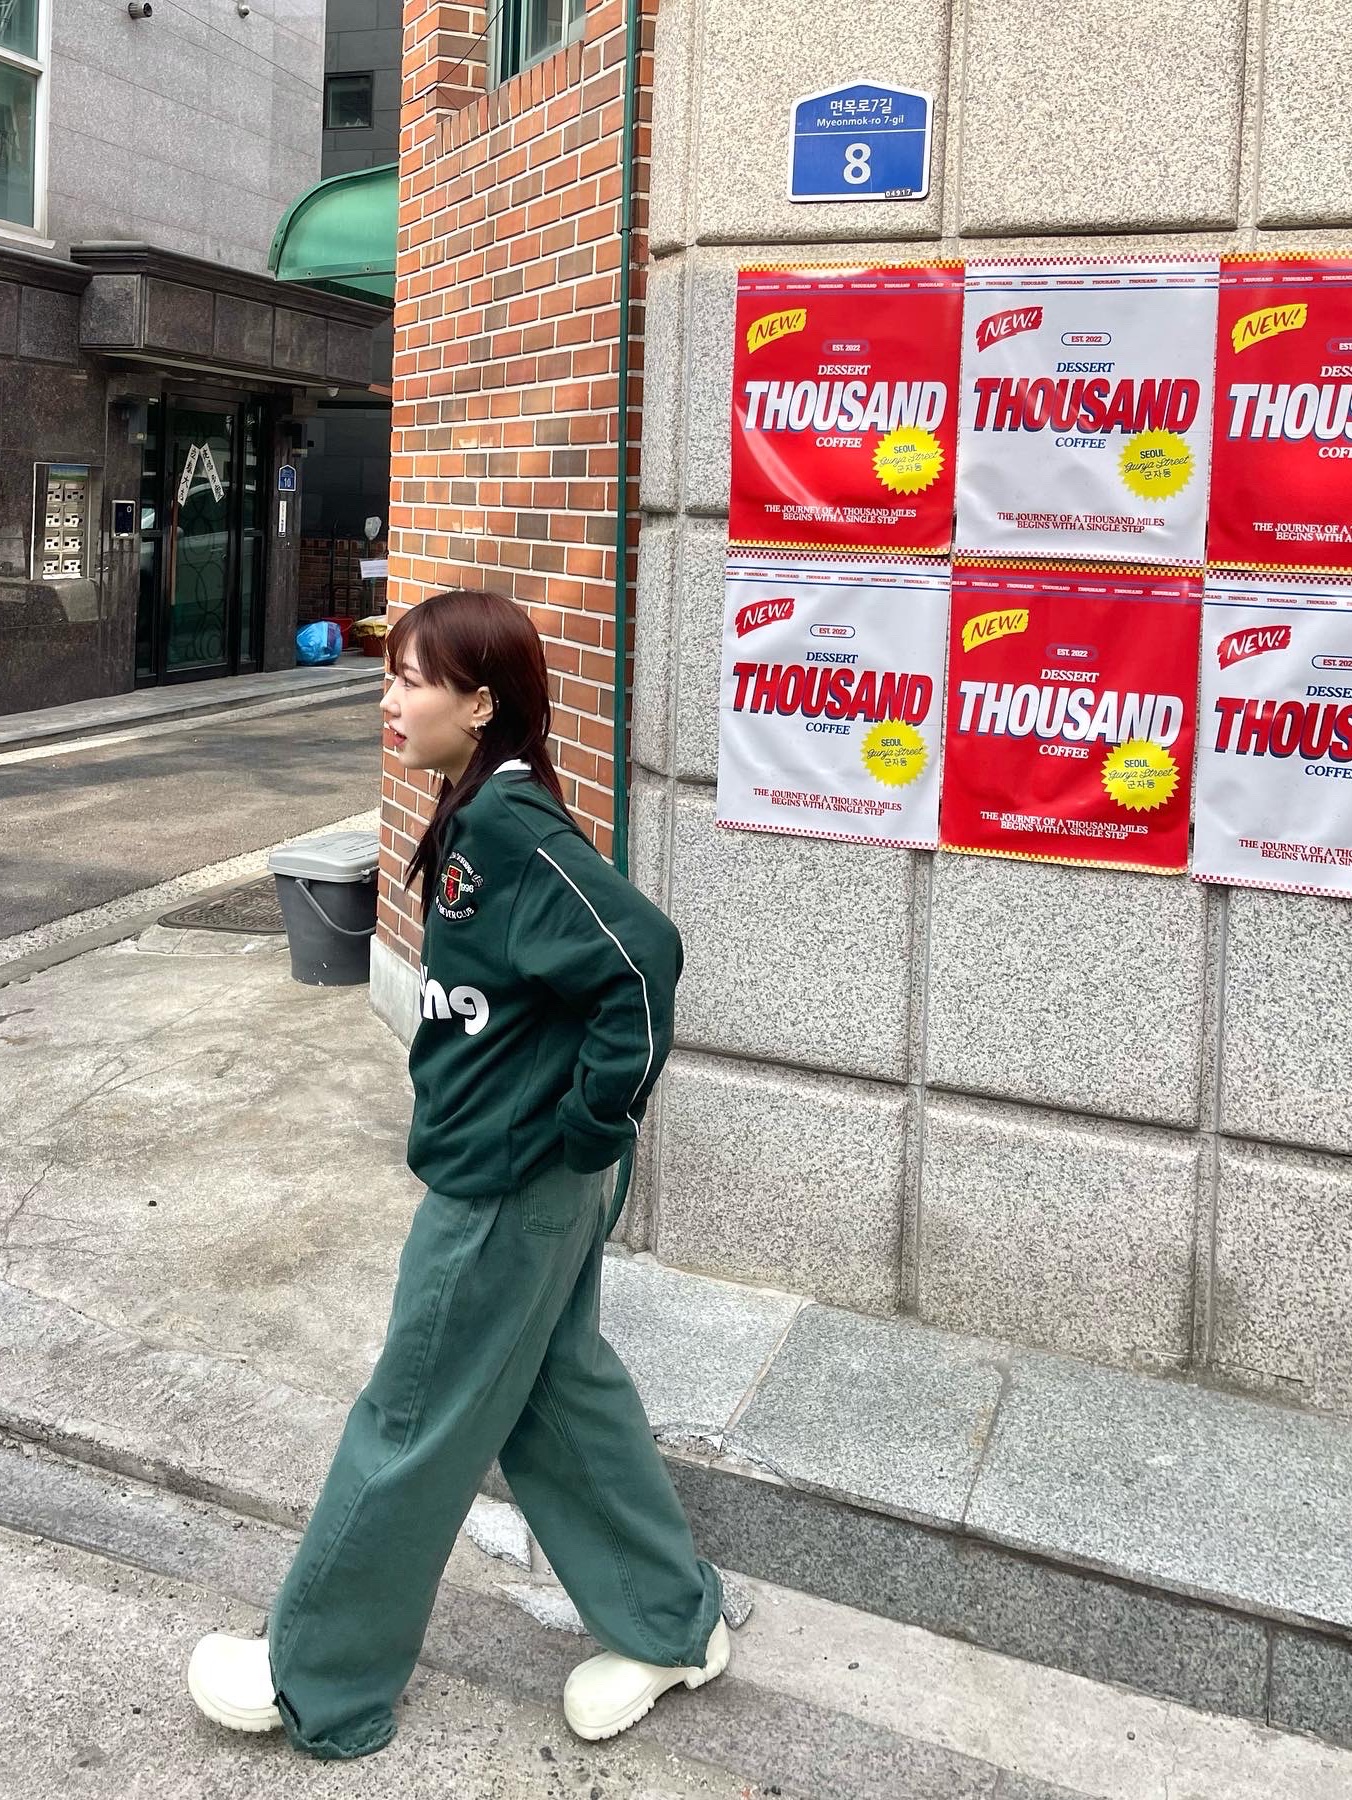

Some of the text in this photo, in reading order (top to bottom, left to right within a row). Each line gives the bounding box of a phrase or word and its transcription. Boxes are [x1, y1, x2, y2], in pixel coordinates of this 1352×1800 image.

[830, 98, 892, 115] 면목로7길
[816, 115, 904, 129] Myeonmok-ro 7-gil
[844, 143, 871, 185] 8
[755, 313, 801, 343] NEW!
[984, 310, 1037, 342] NEW!
[1242, 308, 1300, 342] NEW!
[818, 364, 871, 376] DESSERT
[1056, 362, 1115, 373] DESSERT
[744, 380, 947, 432] THOUSAND
[973, 377, 1201, 434] THOUSAND
[815, 437, 862, 448] COFFEE
[894, 445, 917, 454] SEOUL
[1055, 437, 1106, 449] COFFEE
[1140, 449, 1166, 459] SEOUL
[1156, 456, 1189, 468] Street
[764, 504, 780, 512] THE
[782, 505, 820, 514] JOURNEY
[822, 506, 834, 515] OF
[842, 507, 889, 516] THOUSAND
[891, 509, 917, 517] MILES
[783, 513, 813, 521] BEGINS
[815, 514, 836, 522] WITH
[845, 515, 876, 524] SINGLE
[877, 516, 898, 524] STEP
[997, 512, 1014, 521] THE
[1015, 513, 1059, 522] JOURNEY
[1060, 514, 1072, 523] OF
[1083, 515, 1135, 525] THOUSAND
[1137, 518, 1165, 527] MILES
[1017, 520, 1050, 529] BEGINS
[1051, 522, 1076, 530] WITH
[1087, 523, 1120, 532] SINGLE
[1122, 524, 1145, 533] STEP
[1253, 522, 1348, 534] THE JOURNEY OF A
[1276, 532, 1352, 543] BEGINS WITH A
[743, 602, 790, 630] NEW!
[970, 614, 1023, 642] NEW!
[1227, 629, 1285, 660] NEW!
[806, 651, 858, 664] DESSERT
[1057, 648, 1088, 657] EST. 2022
[1040, 668, 1100, 683] DESSERT
[733, 662, 933, 726] THOUSAND
[958, 681, 1184, 749] THOUSAND
[806, 722, 850, 735] COFFEE
[1215, 697, 1352, 763] THOUS
[881, 738, 902, 747] SEOUL
[894, 747, 923, 757] Street
[1039, 745, 1090, 759] COFFEE
[1124, 759, 1150, 768] SEOUL
[1140, 768, 1173, 778] Street
[753, 788, 769, 796] THE
[770, 789, 808, 801] JOURNEY
[810, 794, 821, 802] OF
[829, 796, 876, 808] THOUSAND
[877, 801, 902, 811] MILES
[771, 797, 800, 807] BEGINS
[802, 800, 824, 809] WITH
[833, 804, 862, 814] SINGLE
[864, 808, 884, 816] STEP
[980, 811, 999, 820] THE
[1000, 812, 1042, 825] JOURNEY
[1043, 816, 1056, 826] OF
[1066, 819, 1118, 832] THOUSAND
[1120, 824, 1148, 834] MILES
[1000, 820, 1033, 832] BEGINS
[1035, 824, 1060, 834] WITH
[1070, 827, 1103, 838] SINGLE
[1104, 831, 1128, 840] STEP
[1239, 839, 1258, 848] THE
[1260, 841, 1307, 853] JOURNEY
[1310, 846, 1324, 854] OF
[1325, 848, 1333, 856] A
[1261, 849, 1298, 860] BEGINS
[1301, 854, 1327, 863] WITH
[1329, 856, 1336, 864] A
[456, 907, 474, 918] CLUB
